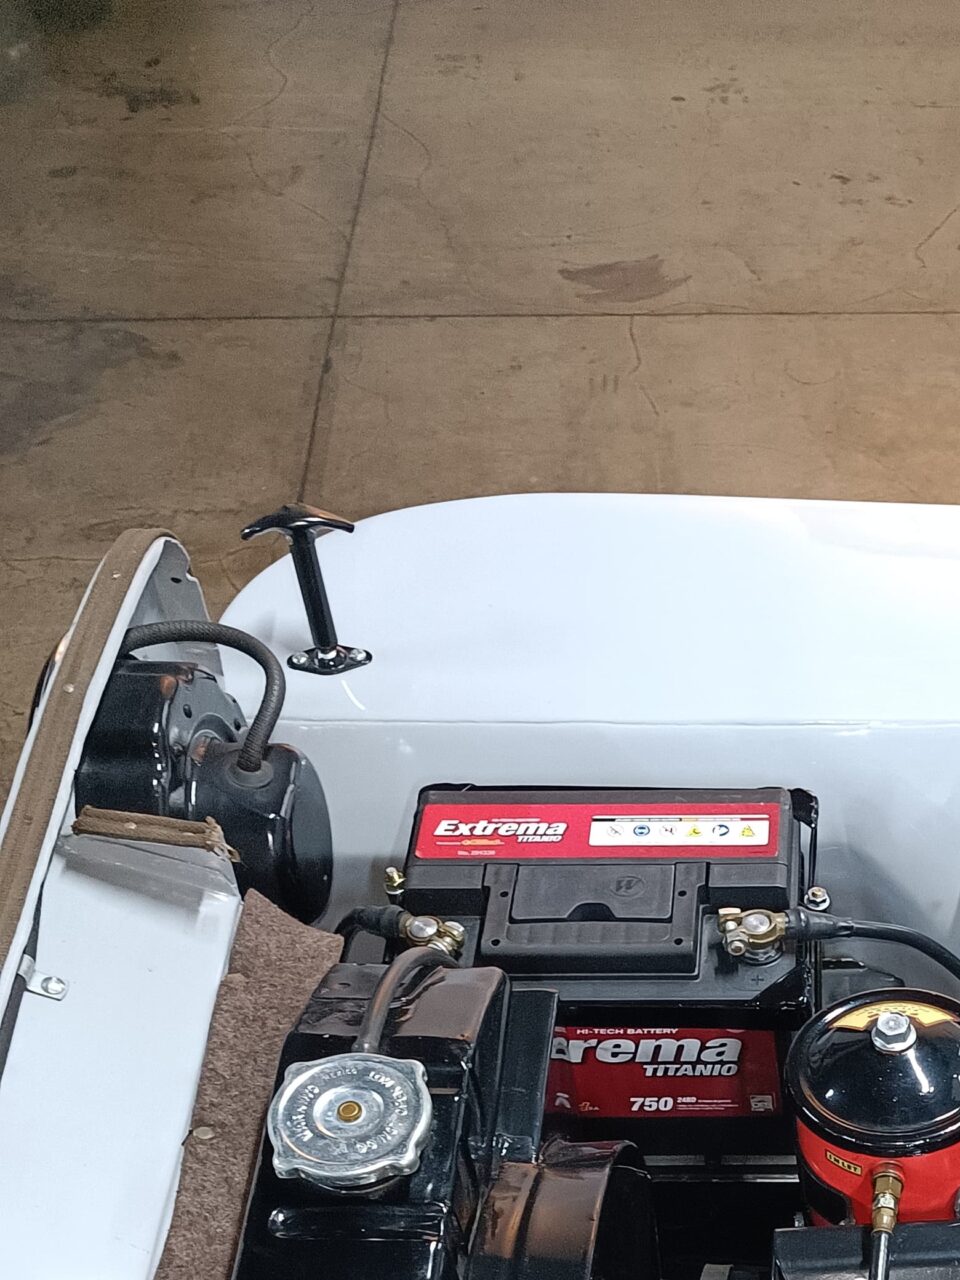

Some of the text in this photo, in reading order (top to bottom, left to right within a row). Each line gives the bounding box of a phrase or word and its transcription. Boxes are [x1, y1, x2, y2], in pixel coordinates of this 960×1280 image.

[433, 819, 568, 836] Extrema
[643, 1064, 738, 1077] TITANIO
[630, 1096, 674, 1111] 750
[828, 1153, 859, 1173] INLET
